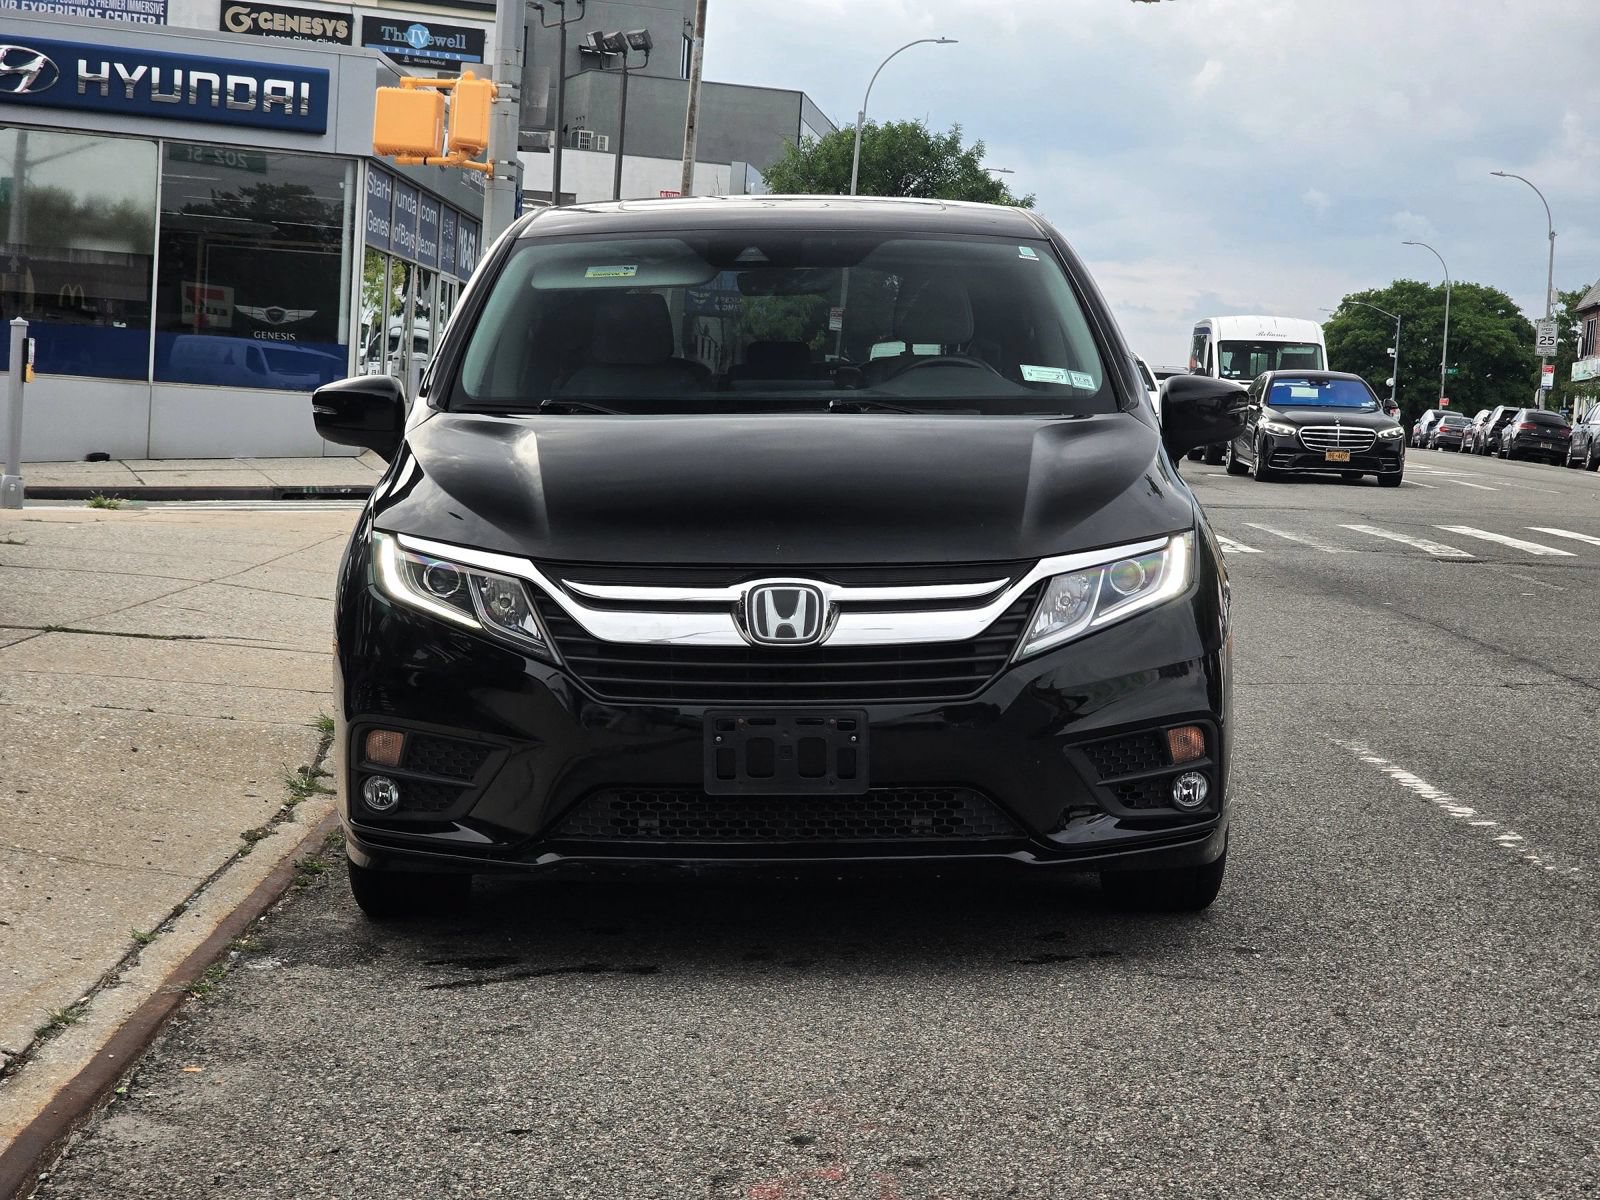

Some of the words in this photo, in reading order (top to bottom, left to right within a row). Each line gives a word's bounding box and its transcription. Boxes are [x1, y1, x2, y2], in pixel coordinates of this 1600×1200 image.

[127, 2, 164, 15] IMMERSIVE
[257, 11, 348, 39] GENESYS
[385, 46, 461, 60] INFUSION
[77, 58, 310, 117] HYUNDAI
[253, 330, 296, 341] GENESIS
[1540, 335, 1555, 346] 25
